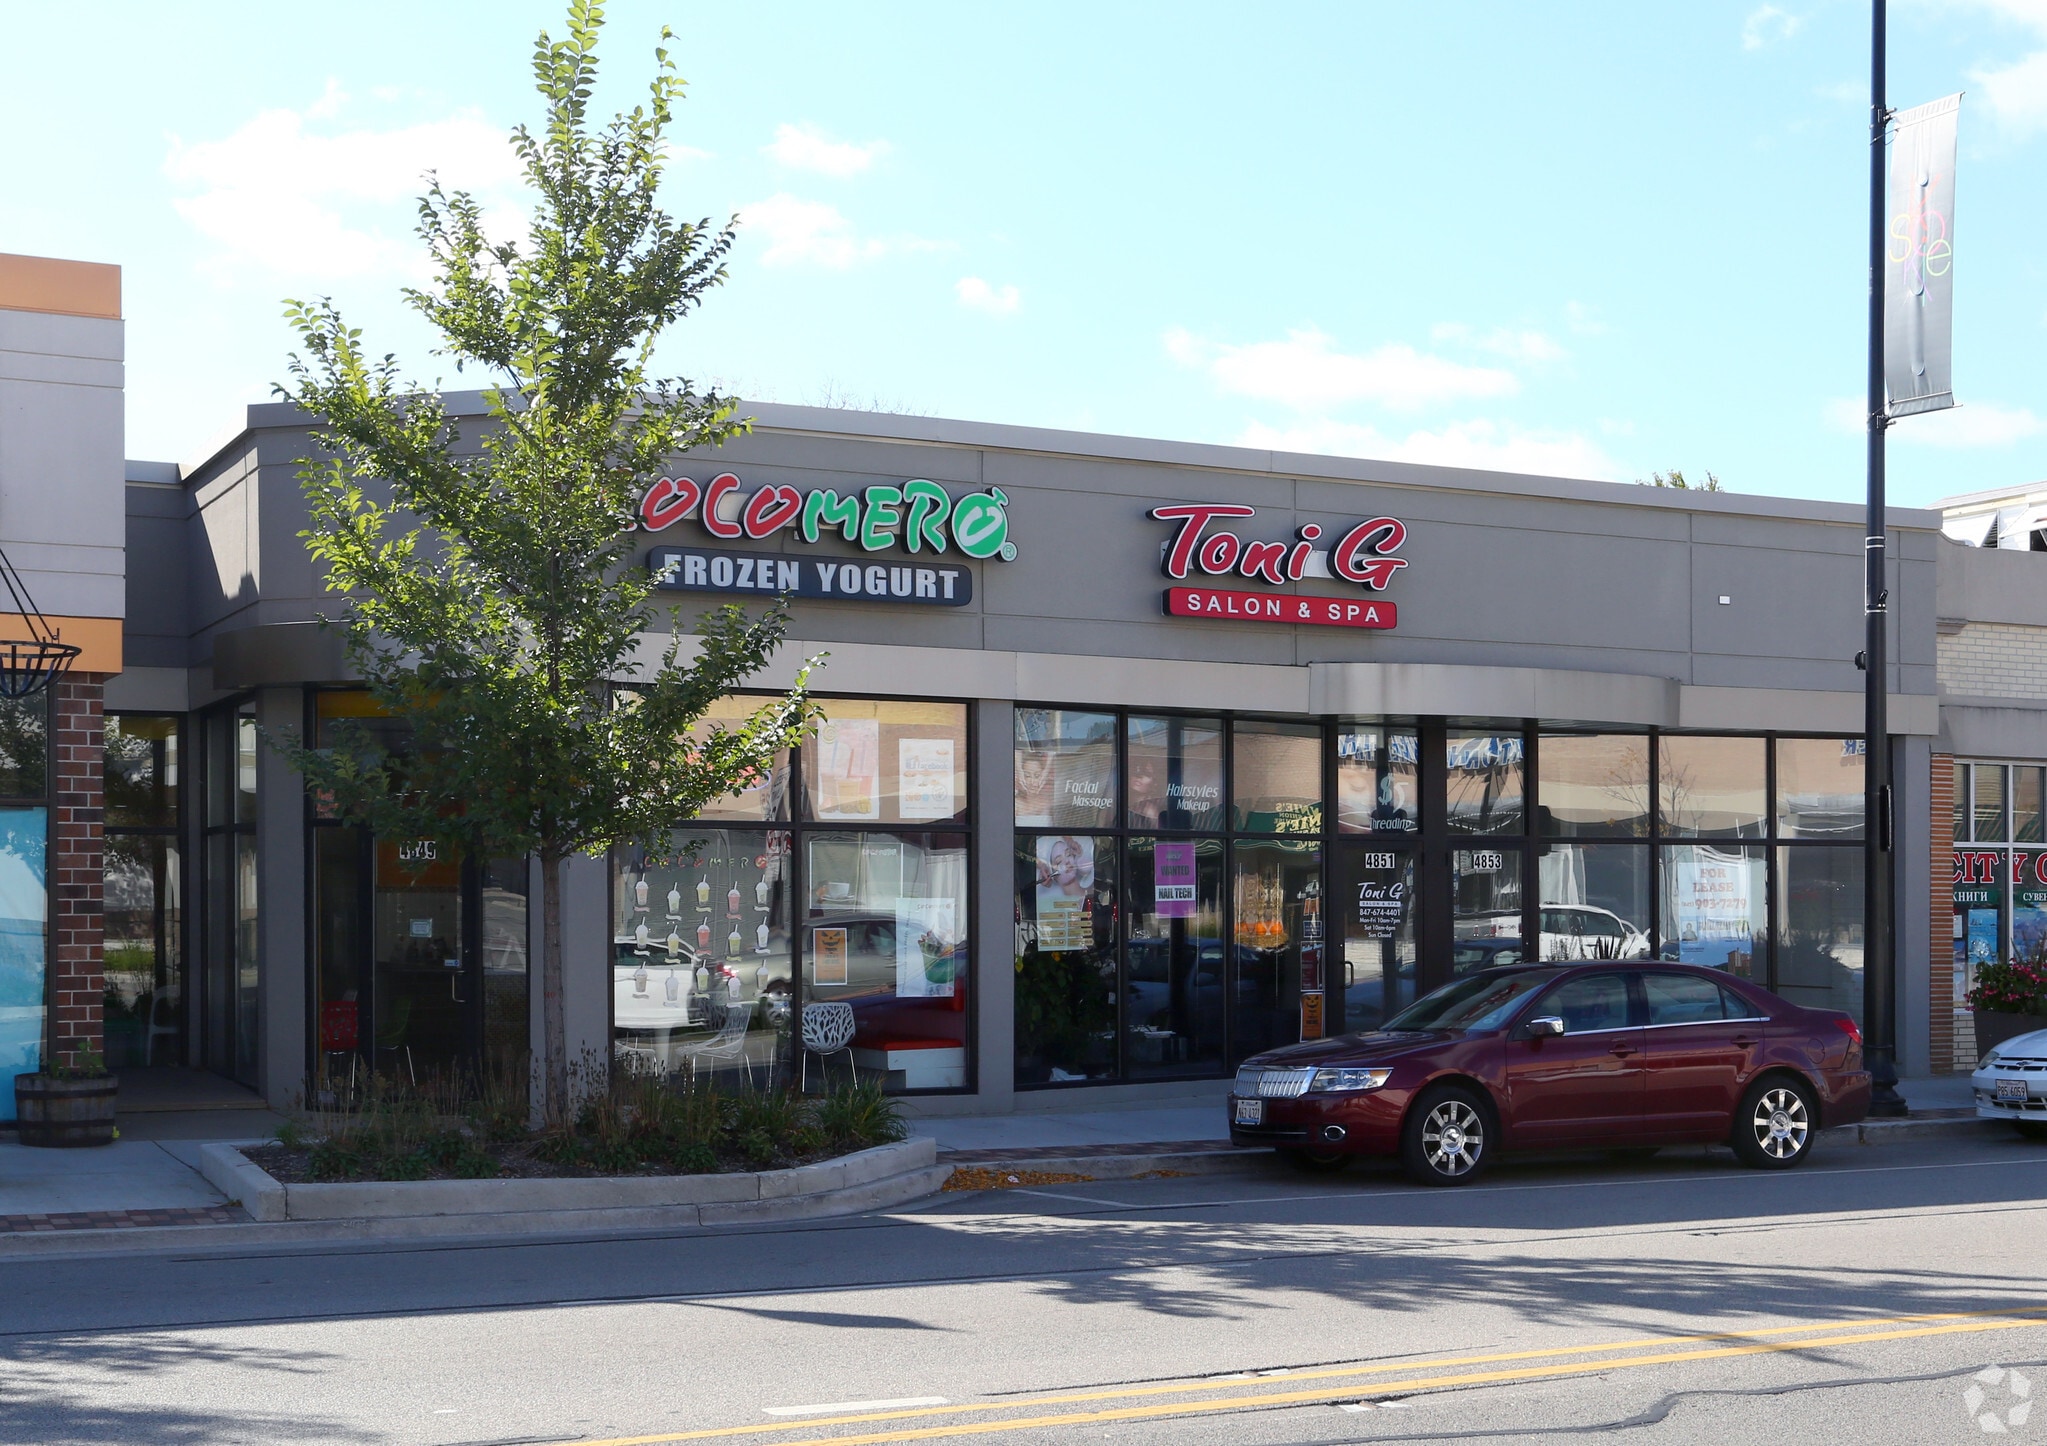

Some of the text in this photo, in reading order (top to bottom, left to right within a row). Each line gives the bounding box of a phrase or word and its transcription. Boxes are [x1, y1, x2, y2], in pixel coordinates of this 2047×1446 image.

[605, 472, 1010, 560] OCOMERO
[1152, 504, 1409, 591] Toni G
[663, 553, 959, 599] FROZEN YOGURT
[1187, 593, 1379, 623] SALON & SPA
[1065, 779, 1099, 794] Facial
[1166, 783, 1219, 799] Hairstyles
[1072, 795, 1113, 809] Massage
[1177, 798, 1210, 812] Makeup
[1366, 853, 1394, 868] 4851
[1474, 854, 1502, 868] 4853
[1700, 868, 1726, 878] FOR
[1158, 887, 1192, 899] NAIL TECH
[1358, 881, 1404, 900] Toni G
[1693, 882, 1734, 893] LEASE
[1360, 908, 1400, 916] 847-674-4401
